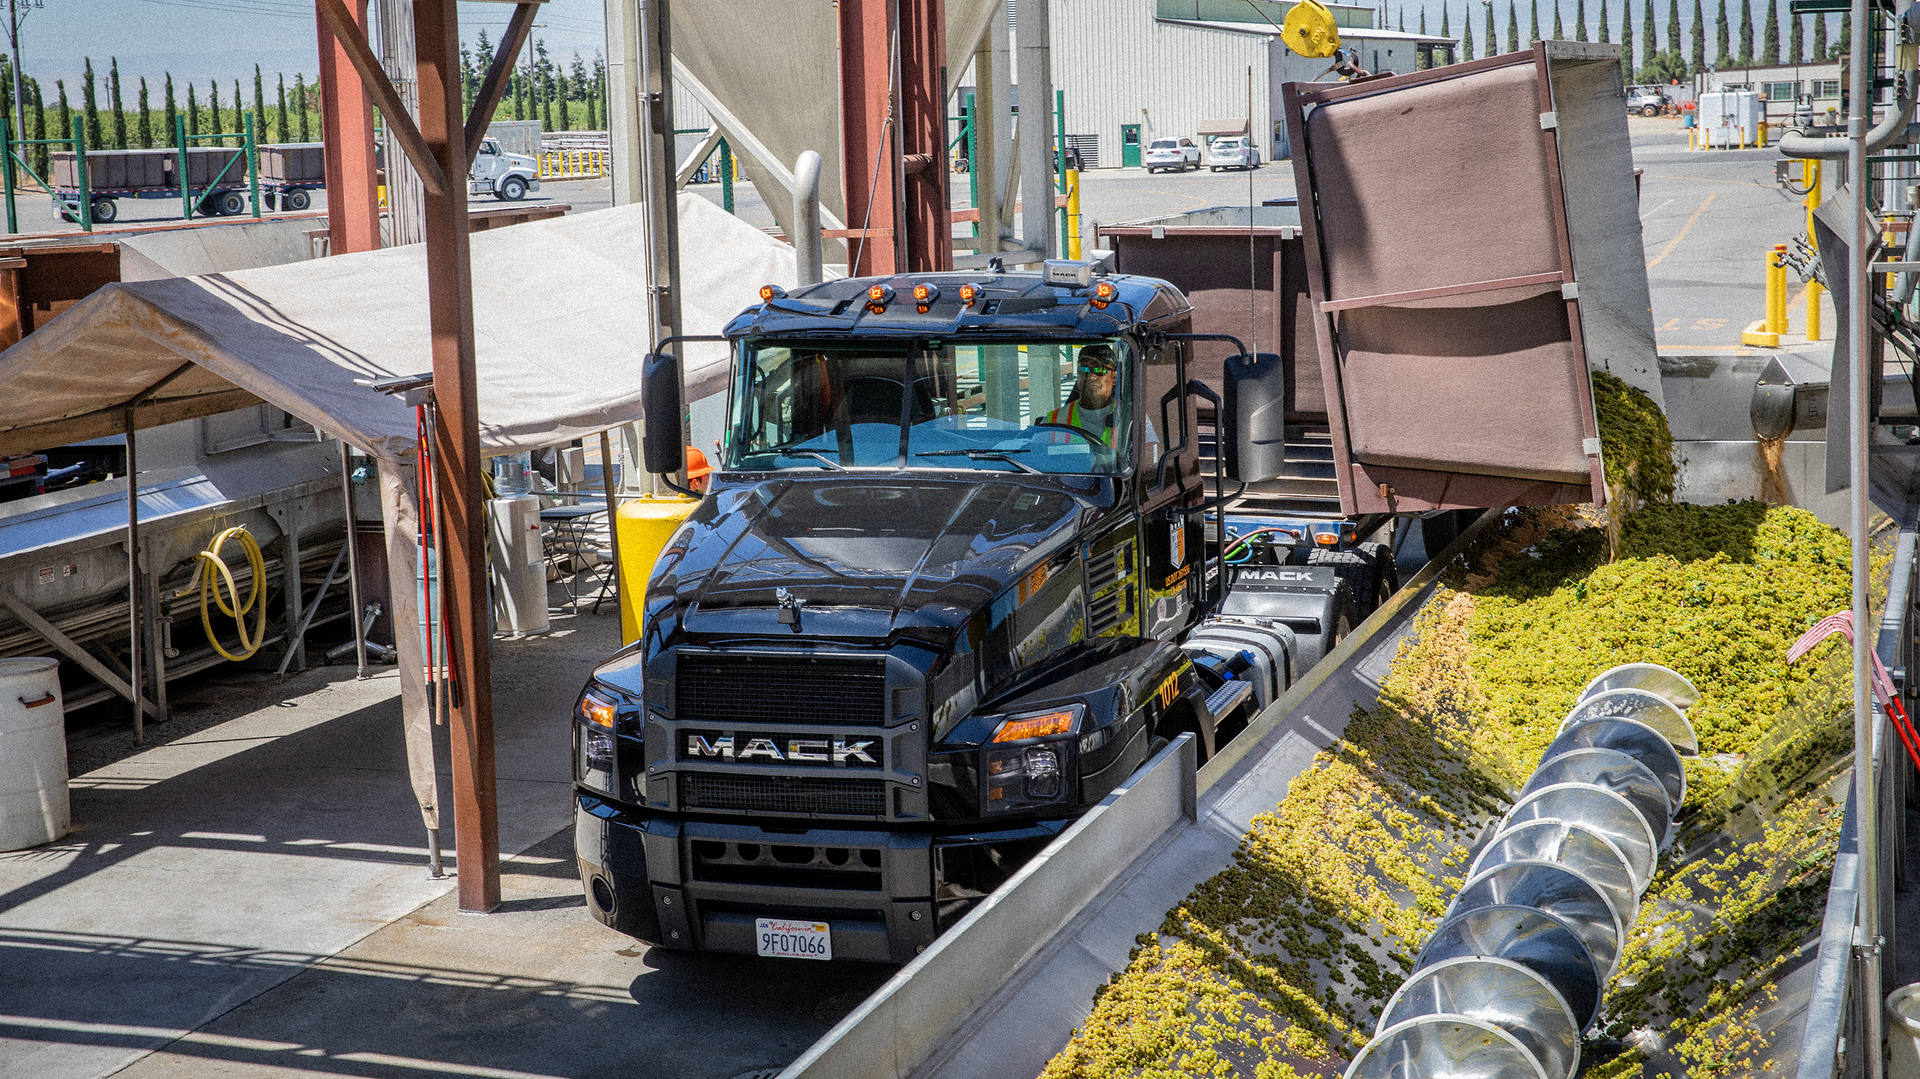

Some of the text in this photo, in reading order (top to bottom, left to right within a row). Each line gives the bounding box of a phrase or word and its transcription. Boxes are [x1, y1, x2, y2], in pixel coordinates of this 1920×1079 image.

[1240, 570, 1314, 582] MACK
[1159, 671, 1180, 710] 1012
[688, 735, 877, 763] MACK
[771, 922, 817, 934] California
[762, 933, 825, 954] 9F07066
